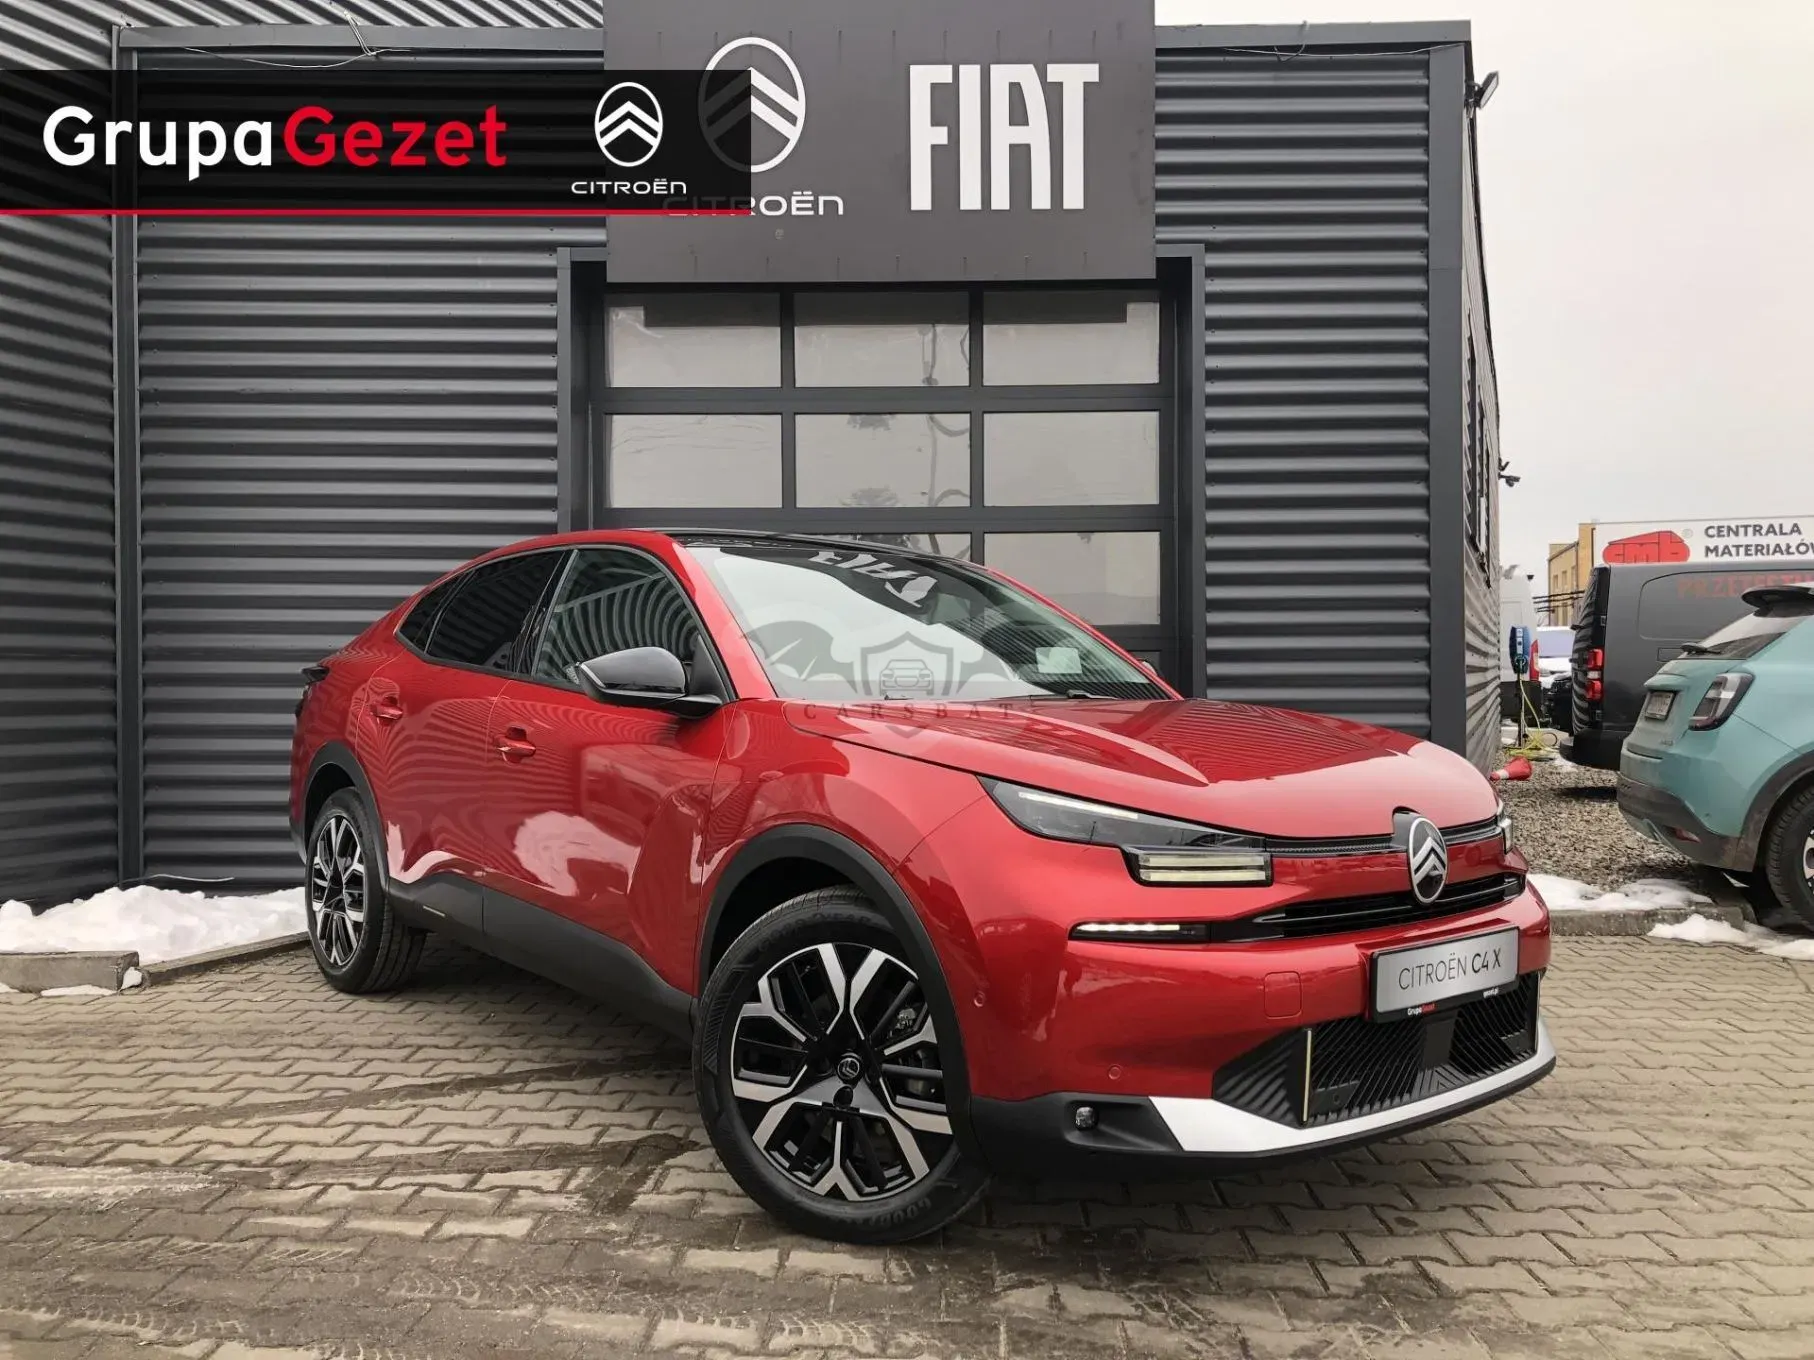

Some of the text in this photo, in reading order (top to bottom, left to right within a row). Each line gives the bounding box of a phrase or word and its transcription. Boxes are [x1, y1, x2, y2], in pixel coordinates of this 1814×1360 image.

[909, 63, 1100, 211] FIAT
[1704, 522, 1802, 538] CENTRALA
[1398, 947, 1502, 990] CITROËN C4 X
